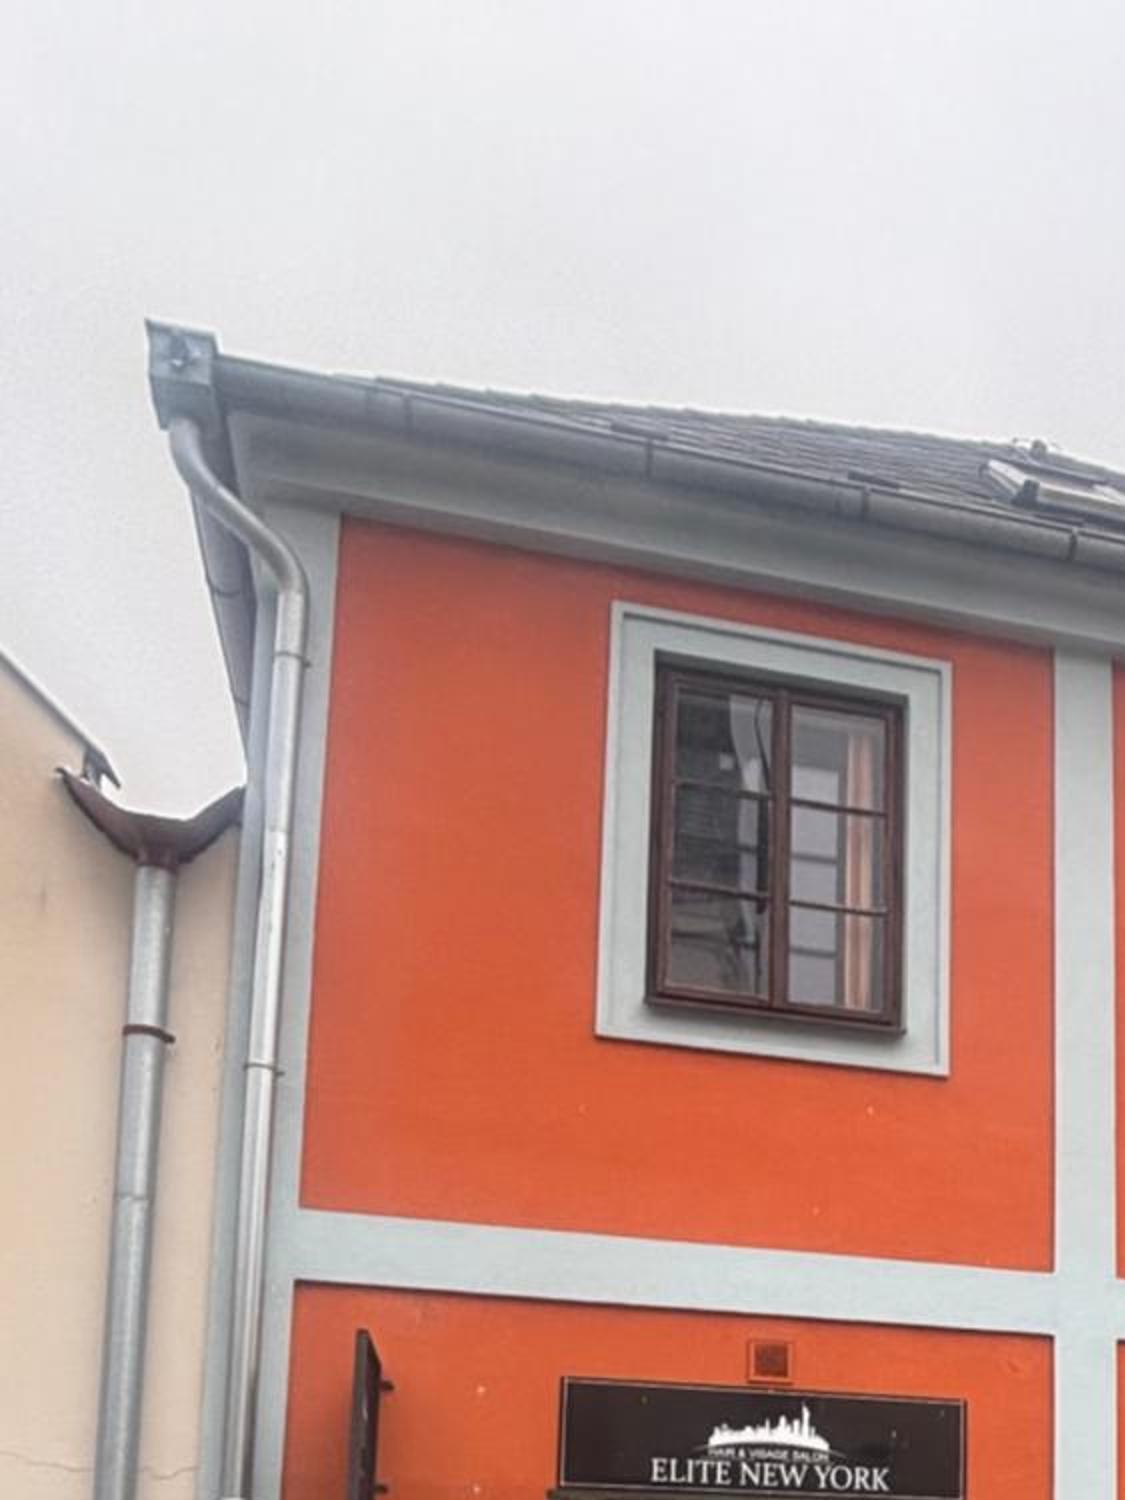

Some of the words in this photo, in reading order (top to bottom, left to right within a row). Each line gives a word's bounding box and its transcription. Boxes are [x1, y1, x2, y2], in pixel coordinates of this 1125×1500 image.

[792, 1449, 829, 1462] SALON
[651, 1457, 731, 1485] ELITE
[740, 1460, 809, 1487] NEW
[815, 1464, 890, 1491] YORK
